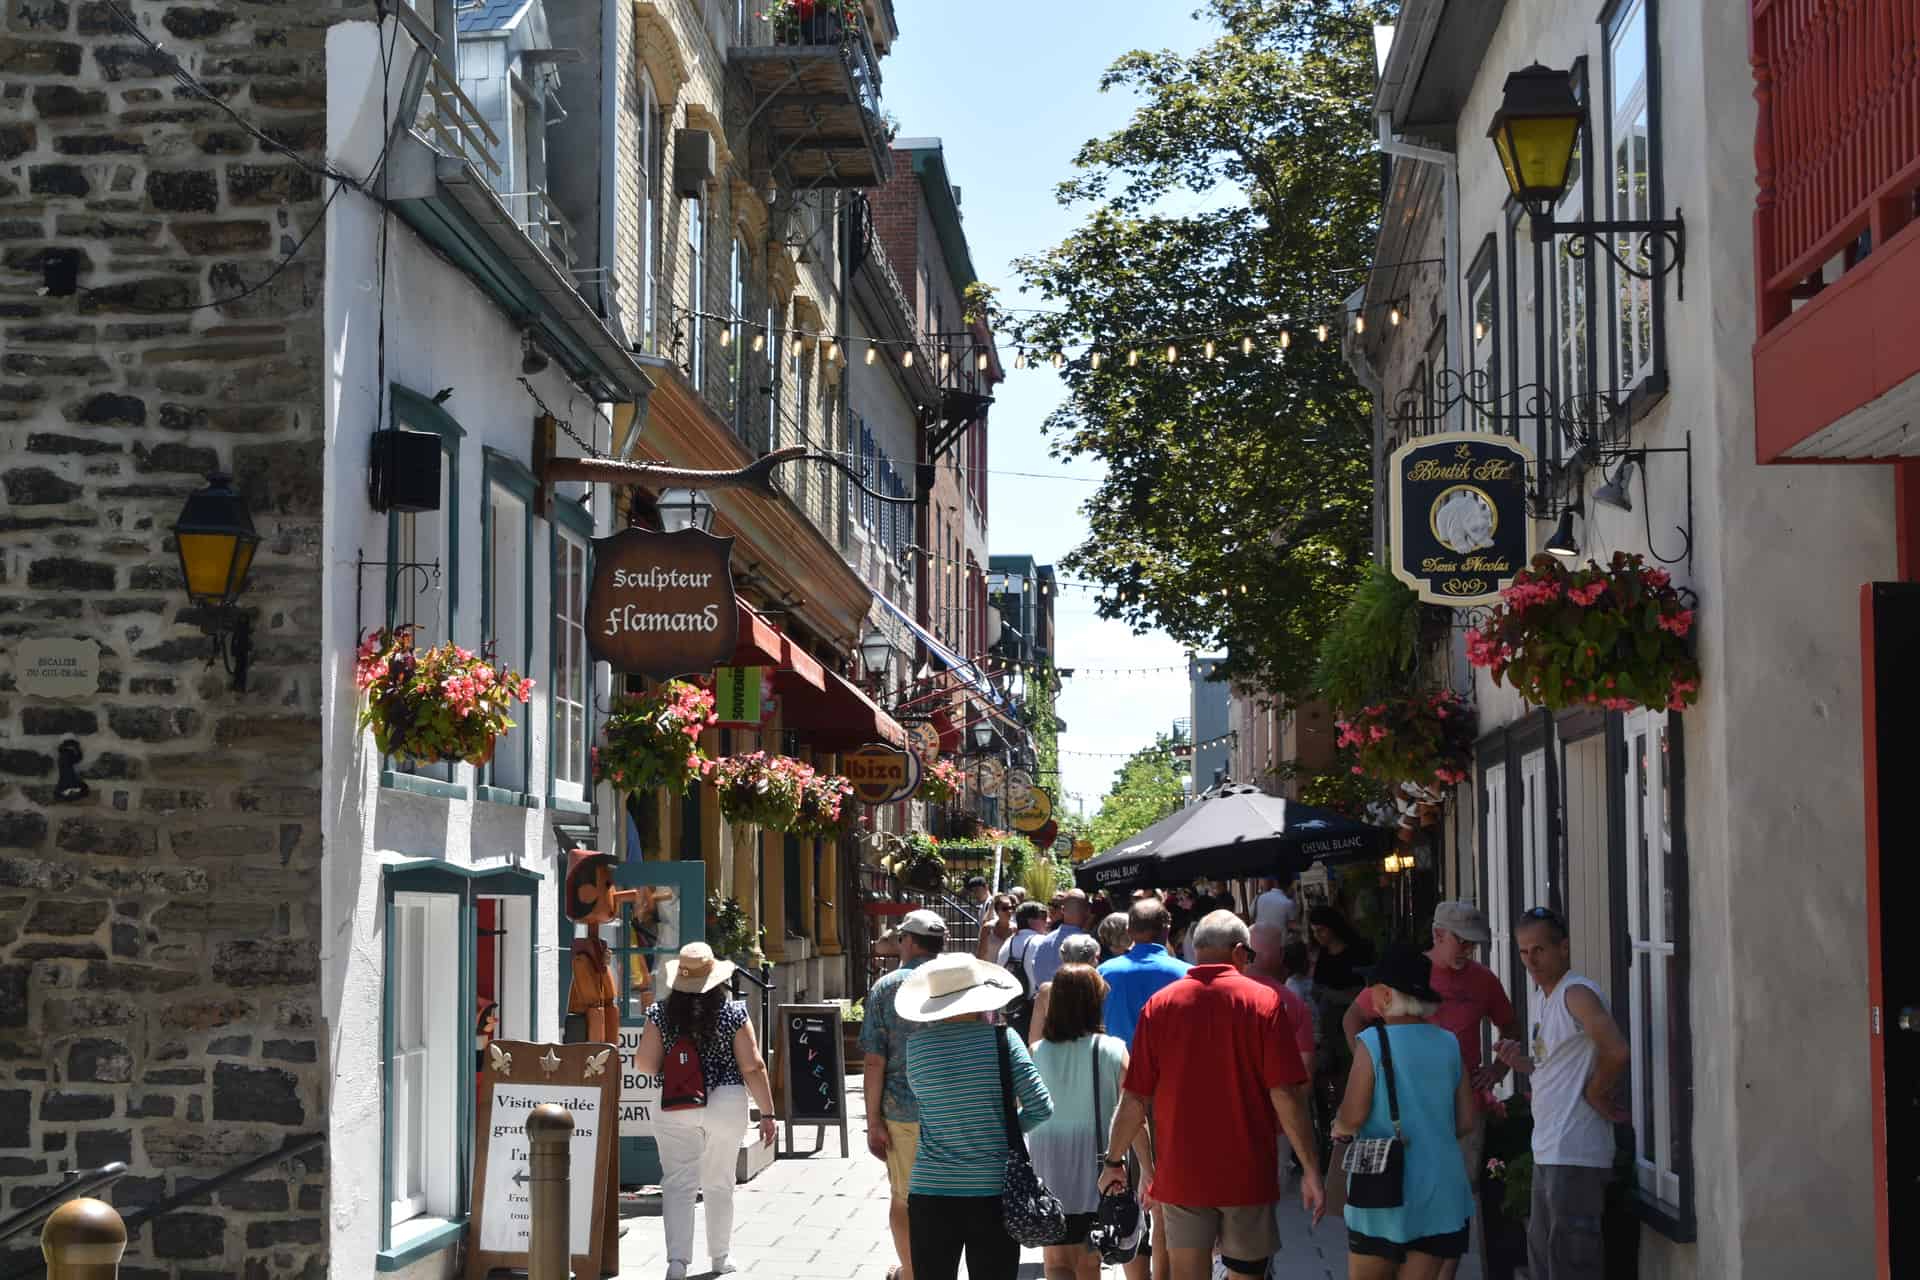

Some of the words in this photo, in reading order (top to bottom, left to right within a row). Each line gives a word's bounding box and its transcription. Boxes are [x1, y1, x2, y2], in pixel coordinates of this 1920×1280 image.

[612, 566, 712, 592] Sculpteur
[603, 603, 719, 636] Flamand
[845, 759, 902, 779] Ibiza
[1332, 834, 1362, 849] BLANC
[544, 1097, 596, 1111] idée
[493, 1125, 526, 1137] grat
[510, 1148, 528, 1161] l'a
